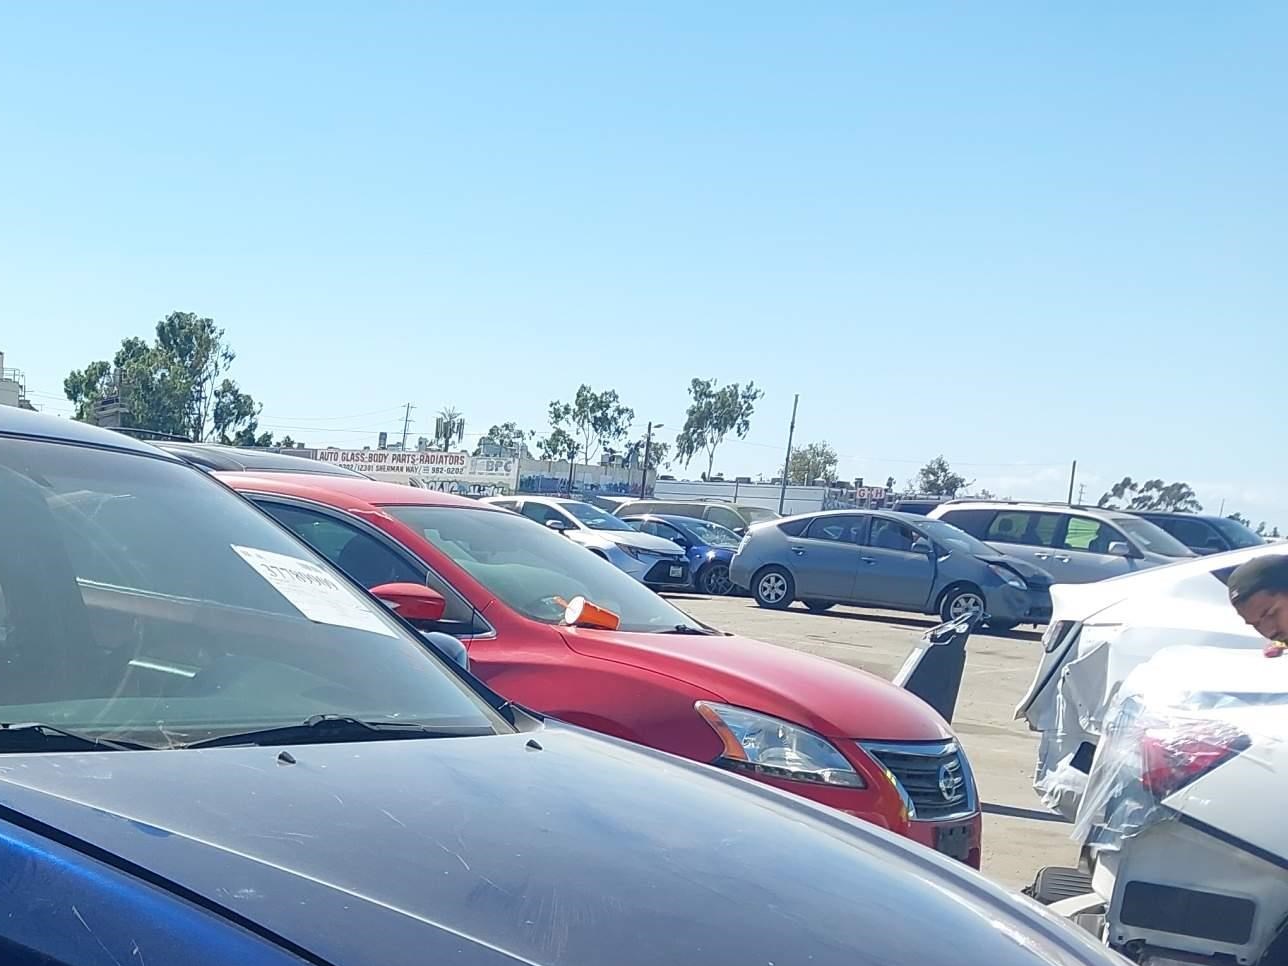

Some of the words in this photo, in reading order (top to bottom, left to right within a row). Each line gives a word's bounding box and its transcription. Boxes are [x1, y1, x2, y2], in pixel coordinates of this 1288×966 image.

[319, 451, 339, 462] AUTO
[341, 452, 389, 463] GLASS-BODY
[391, 453, 465, 465] PARTS-RADIATORS
